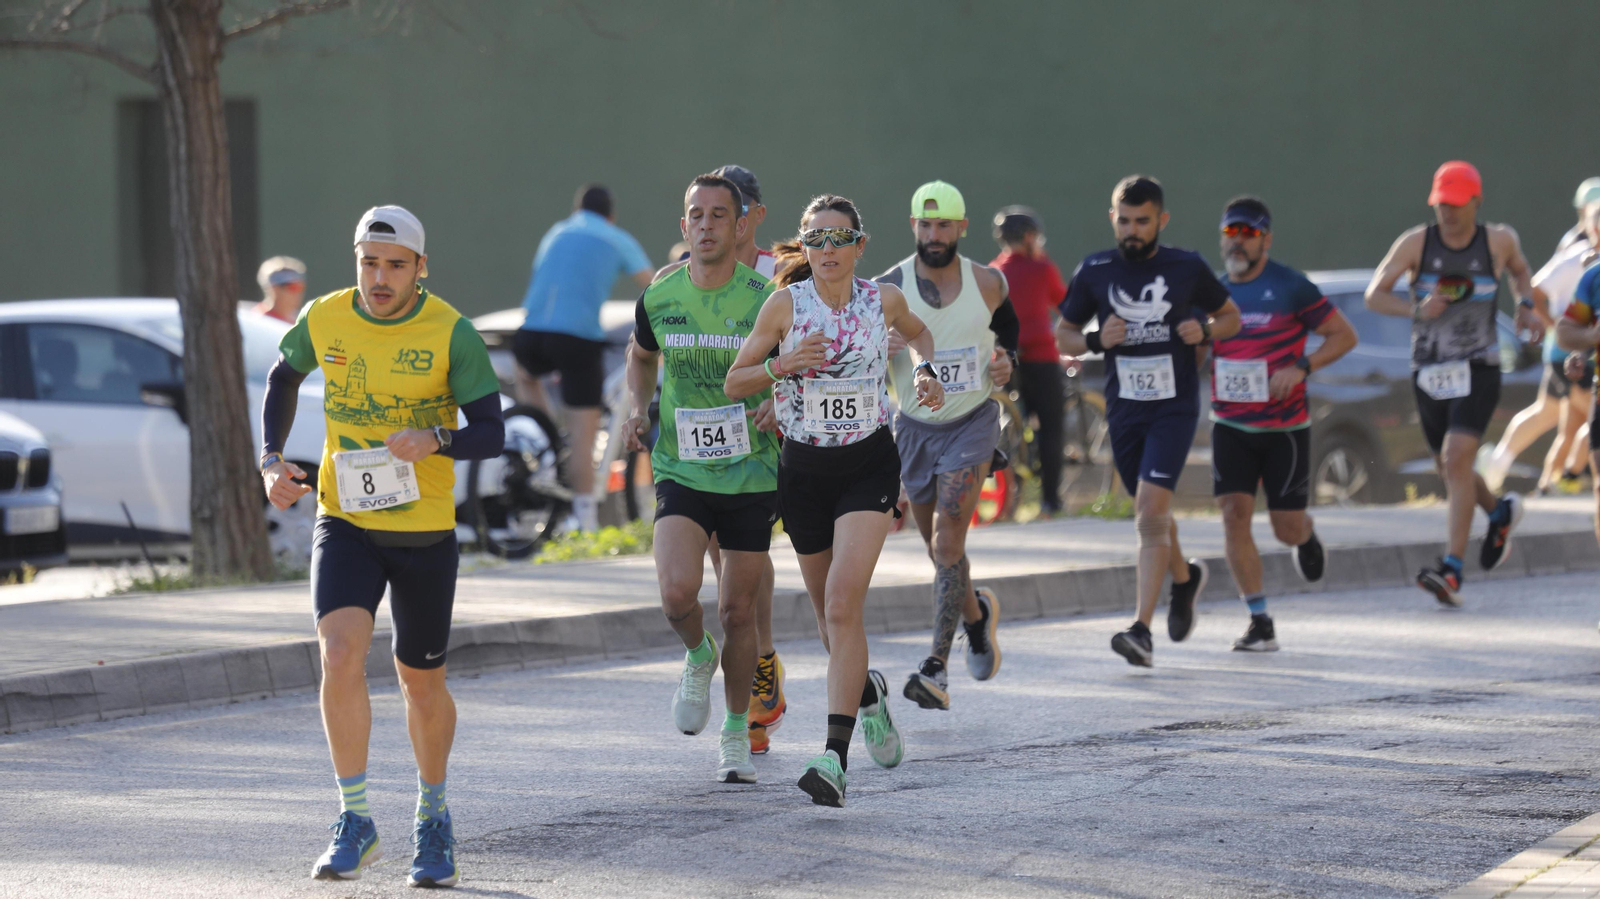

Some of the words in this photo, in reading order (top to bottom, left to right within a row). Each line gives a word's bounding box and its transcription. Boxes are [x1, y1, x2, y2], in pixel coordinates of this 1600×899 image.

[747, 278, 765, 291] 2023
[662, 316, 687, 326] HOKA
[736, 319, 754, 330] edp
[1126, 322, 1171, 340] ARATÓN
[665, 333, 695, 347] MEDIO
[1129, 373, 1156, 391] 162
[942, 385, 966, 393] VOS
[820, 398, 857, 419] 185
[824, 423, 860, 431] EVOS
[691, 425, 727, 447] 154
[697, 448, 732, 458] EVOS
[362, 472, 376, 495] 8
[358, 496, 398, 509] EVOS
